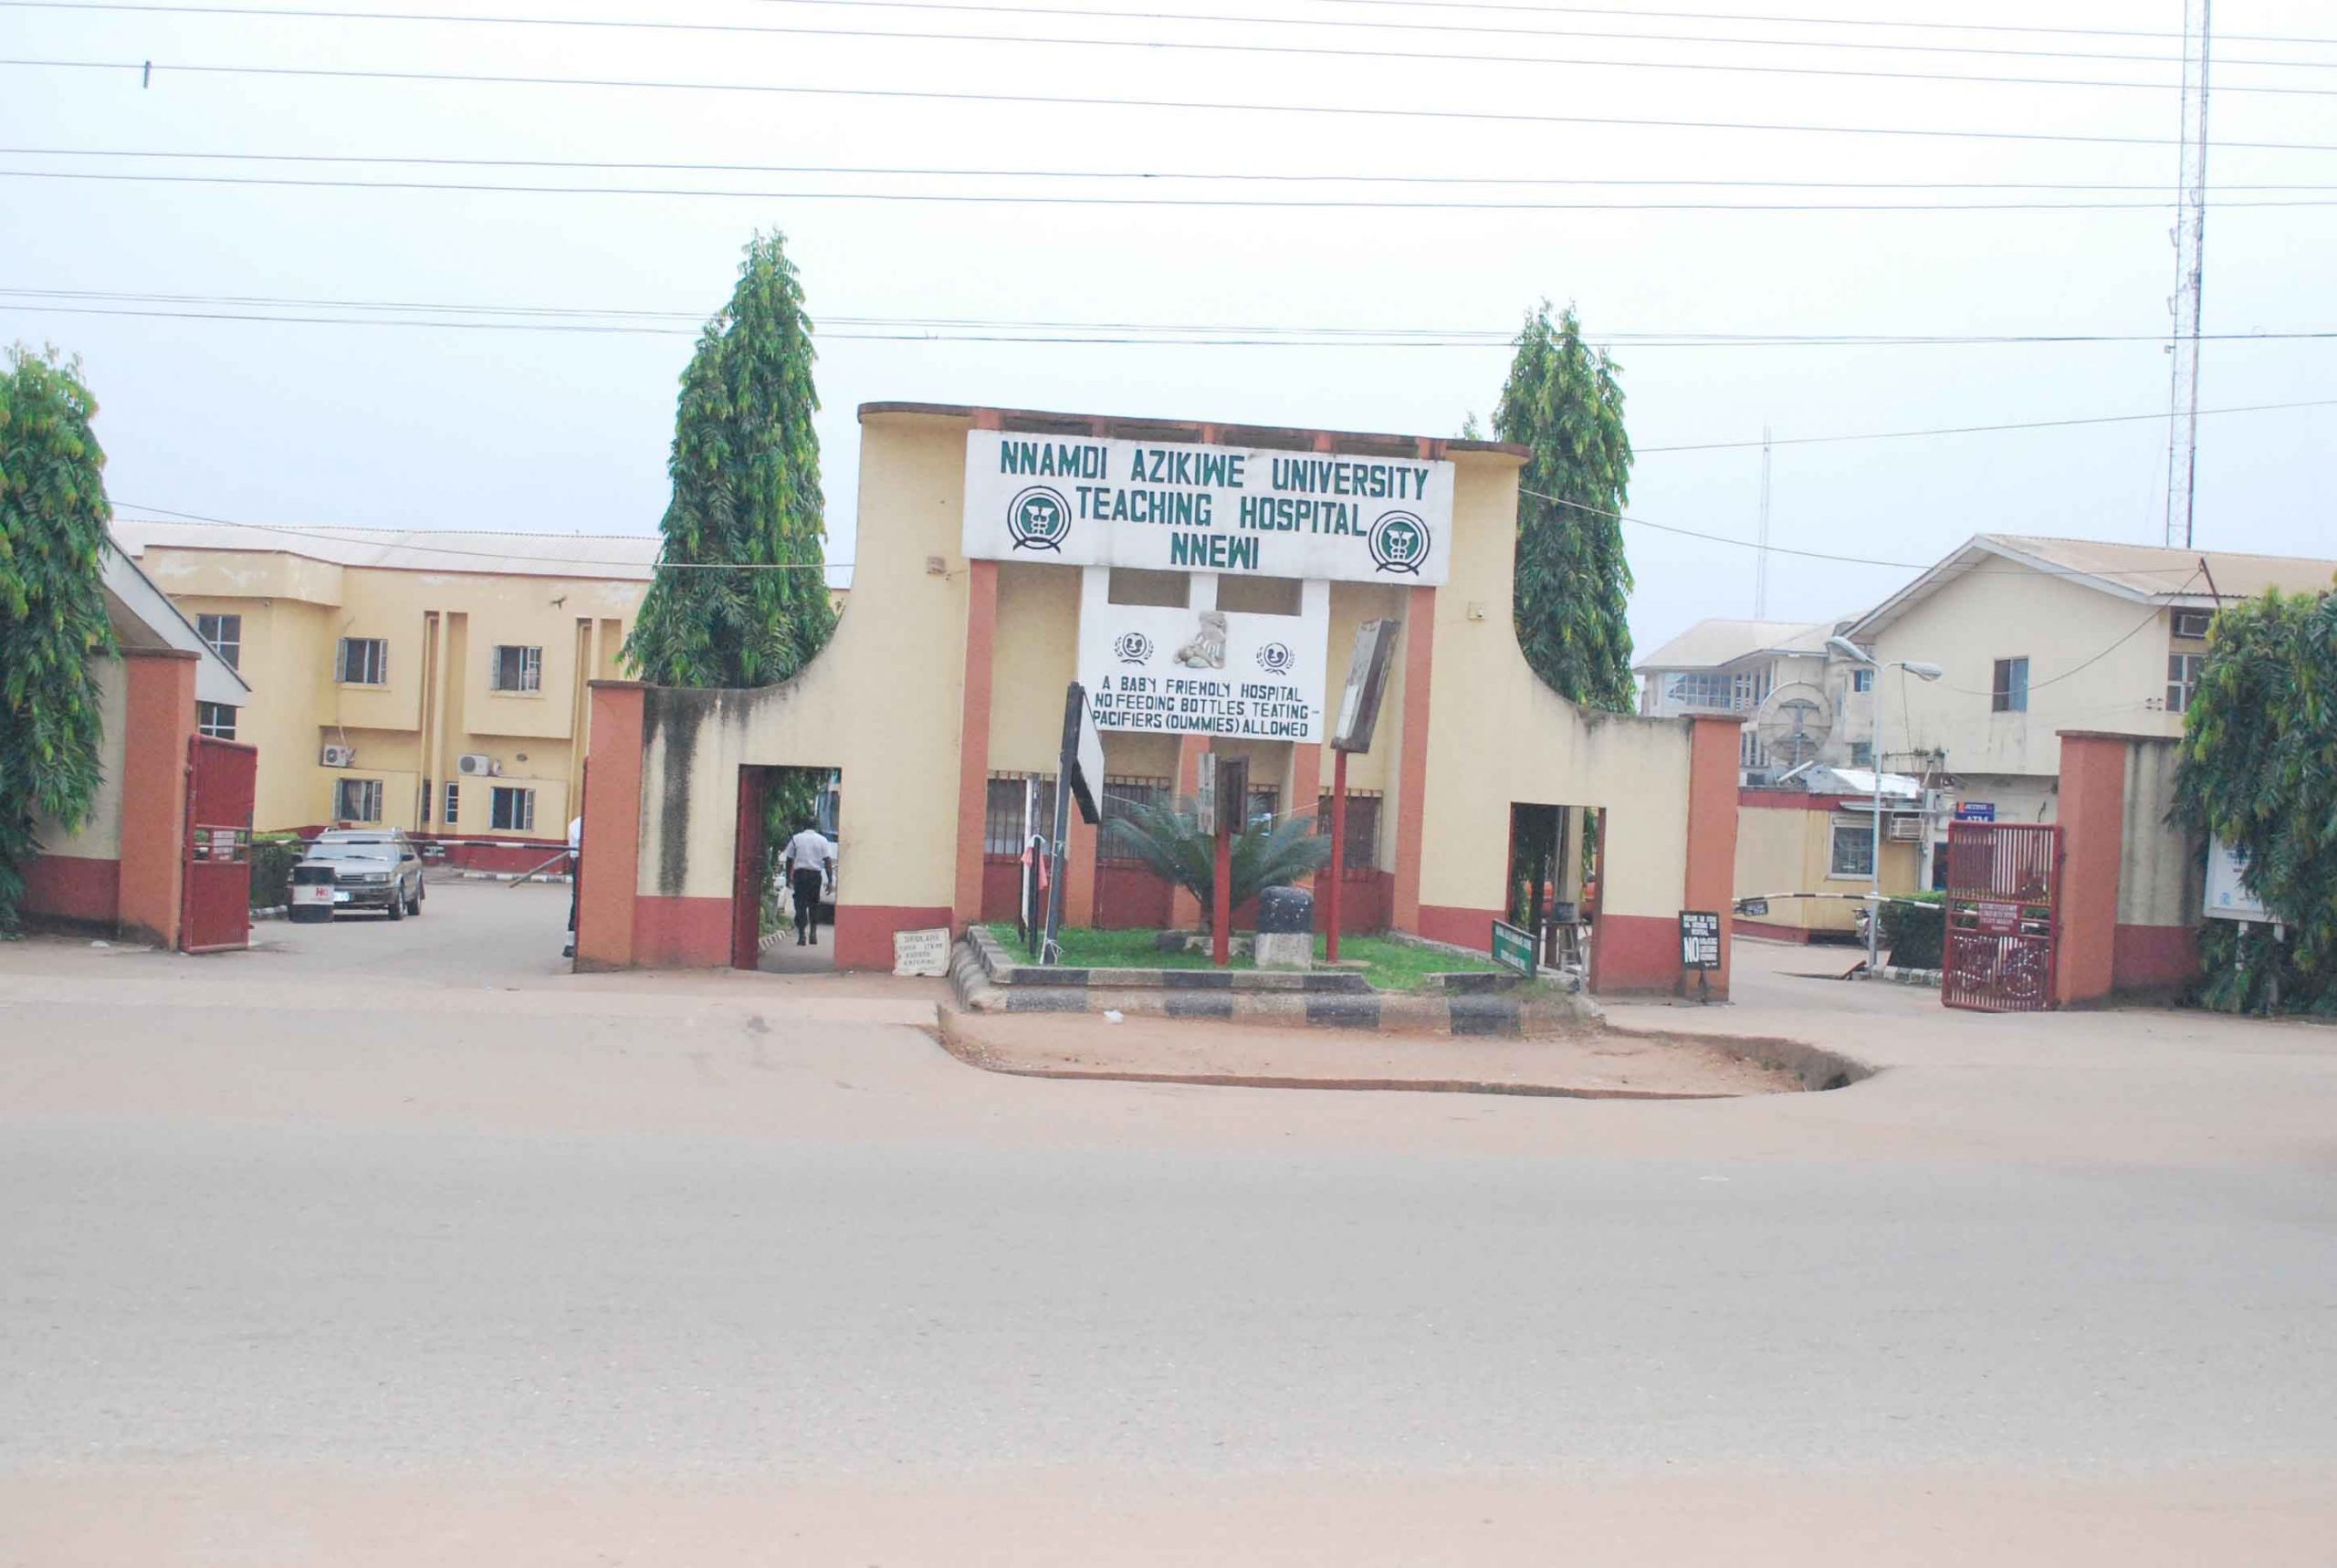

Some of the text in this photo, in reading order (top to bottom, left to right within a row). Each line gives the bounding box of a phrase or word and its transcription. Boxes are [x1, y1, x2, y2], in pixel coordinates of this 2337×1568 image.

[1001, 440, 1429, 500] NNAMDI AZIKIWE UNIVERSITY
[1075, 486, 1368, 537] TEACHING HOSPITAL
[1170, 532, 1259, 570] NNEWI
[1102, 675, 1303, 703] A BABY FRIENDLY HOSPITAL
[1095, 692, 1113, 707] NO
[1116, 694, 1176, 712] FEEDING
[1180, 698, 1244, 716] BOTTLES
[1093, 710, 1308, 737] PACIFIERS (DUMMIES) ALLOWED
[1683, 936, 1699, 963] NO
